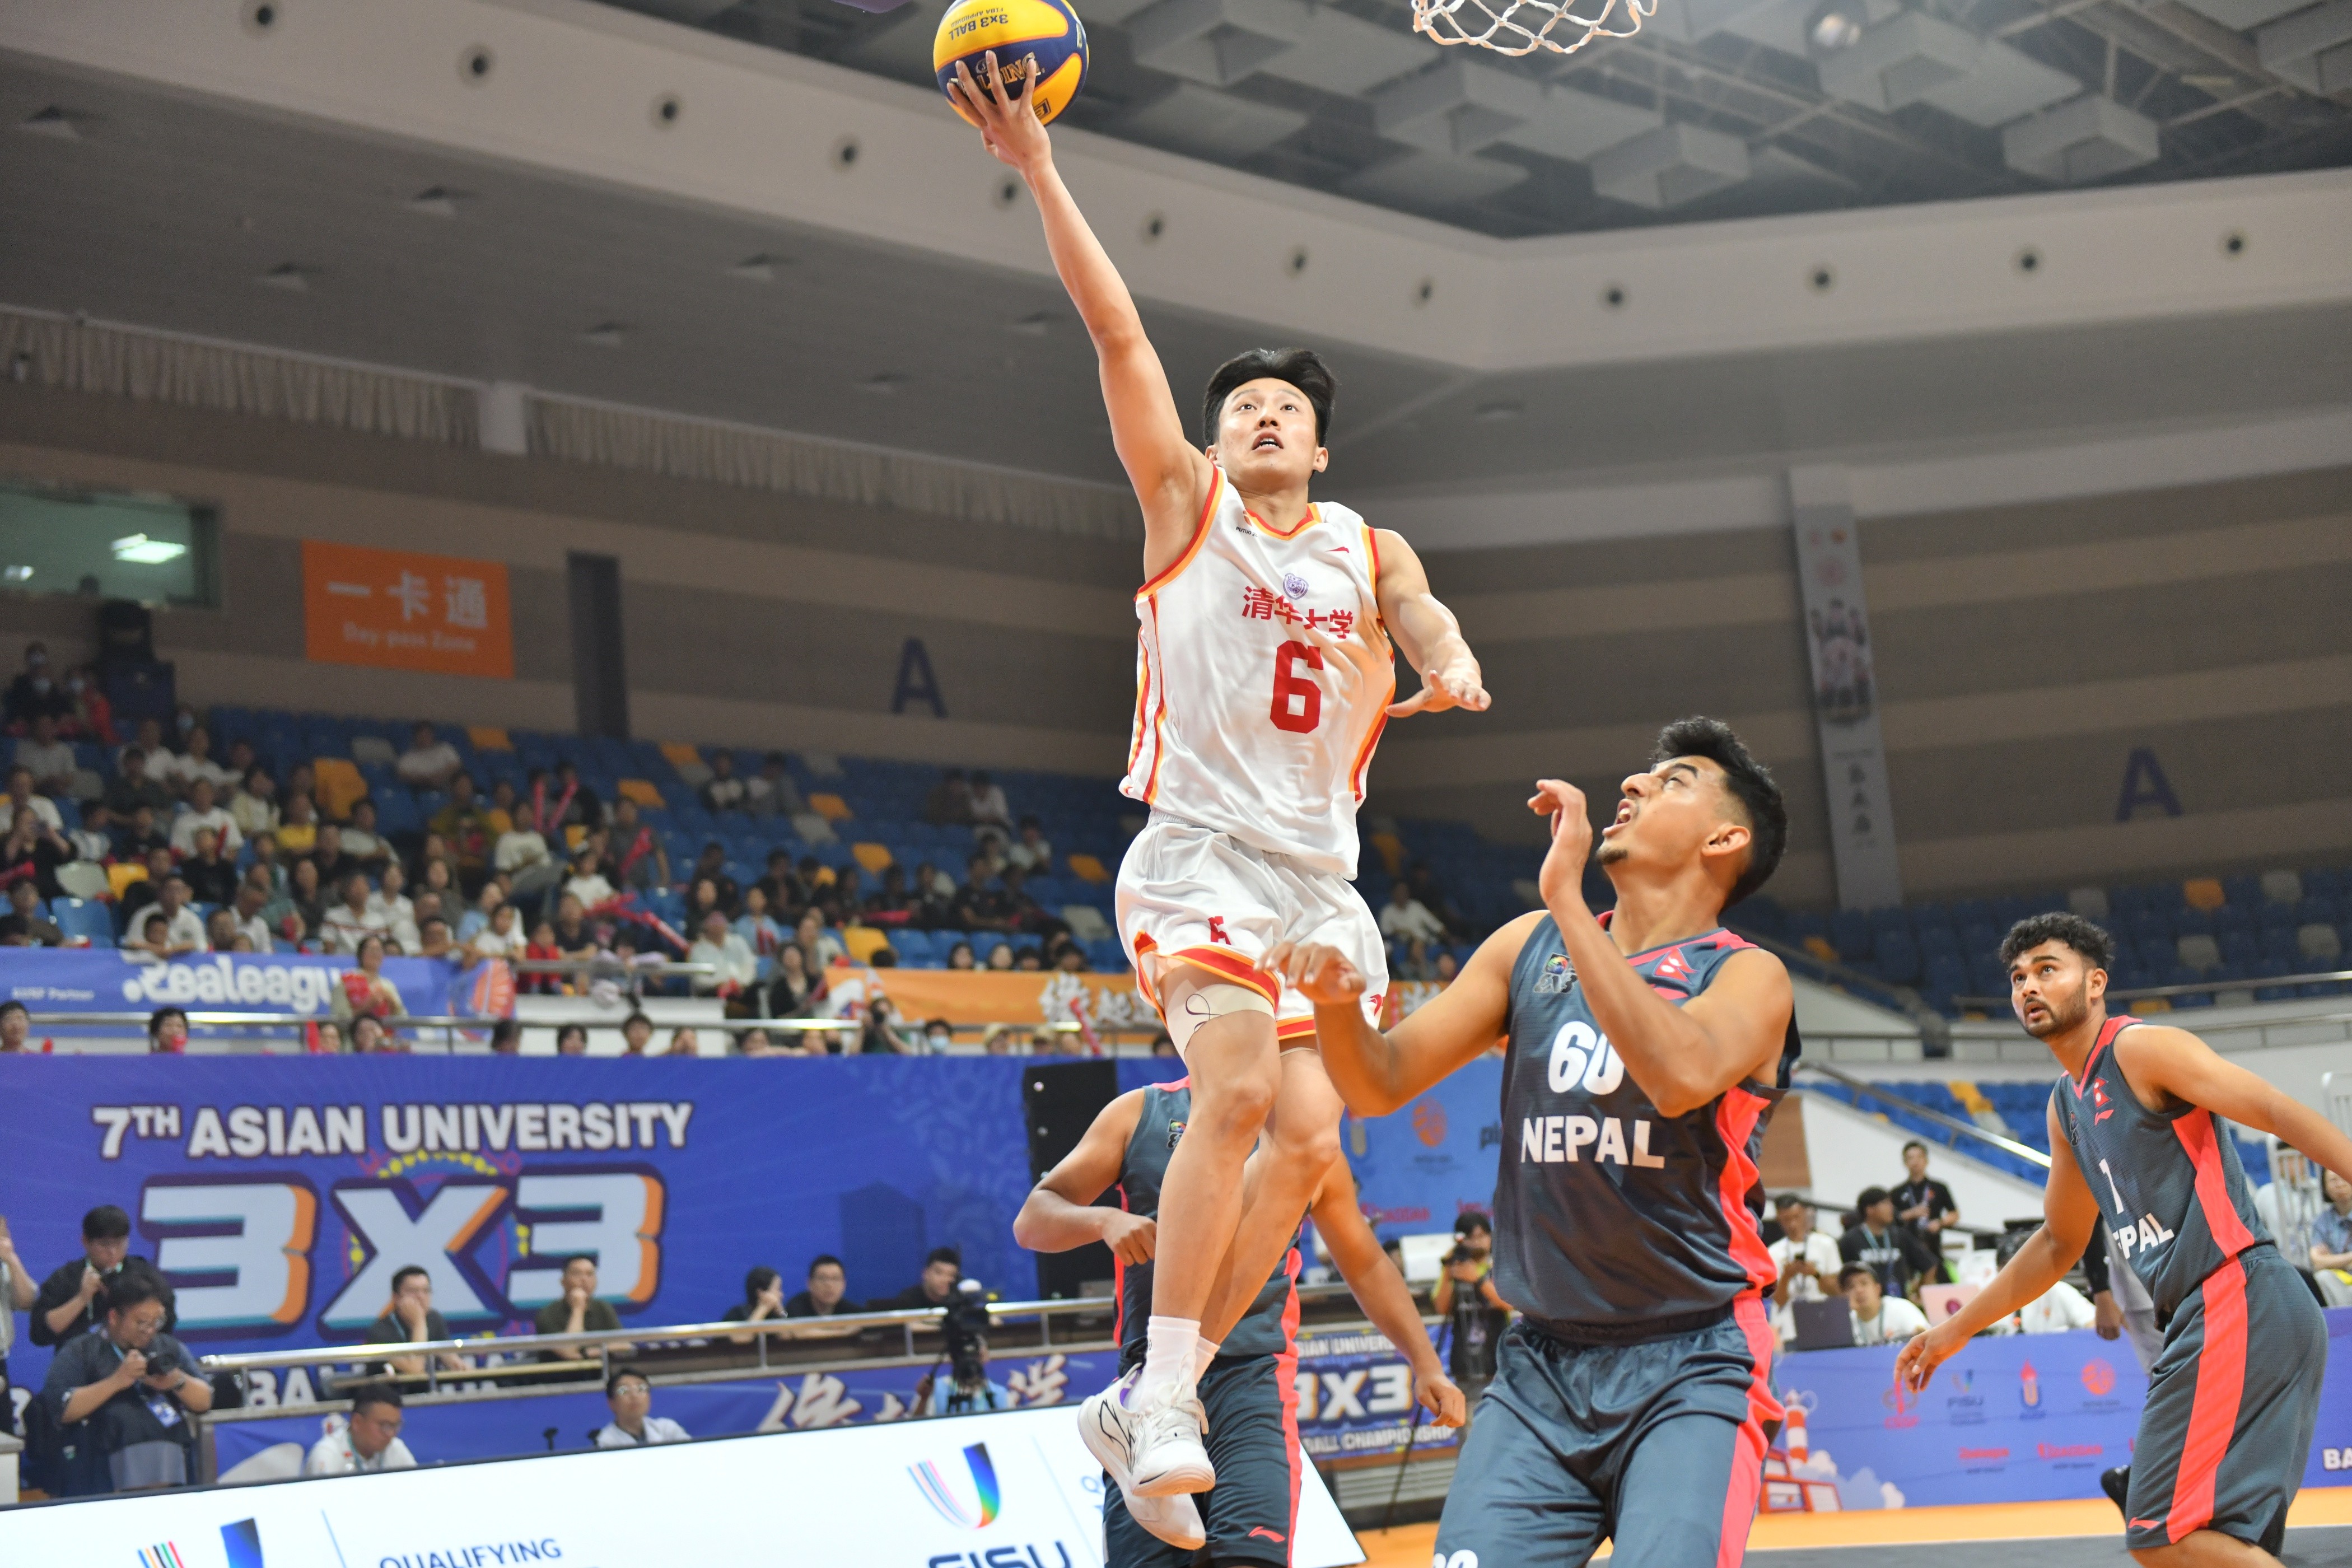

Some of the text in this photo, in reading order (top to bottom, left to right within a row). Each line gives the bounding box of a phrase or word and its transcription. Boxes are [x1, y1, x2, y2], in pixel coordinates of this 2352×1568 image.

[948, 14, 1009, 40] 3x3 BALL
[1236, 526, 1252, 535] PUTUO
[326, 571, 488, 629] 一卡通
[1242, 586, 1354, 639] 清华大学
[890, 638, 949, 718] A
[1270, 640, 1324, 734] 6
[2115, 748, 2182, 822] A
[1547, 1020, 1625, 1095] 60
[93, 1102, 693, 1159] 7TH ASIAN UNIVERSITY
[1521, 1114, 1665, 1169] NEPAL
[141, 1174, 664, 1332] 3X3
[380, 1538, 563, 1568] QUALIFYING
